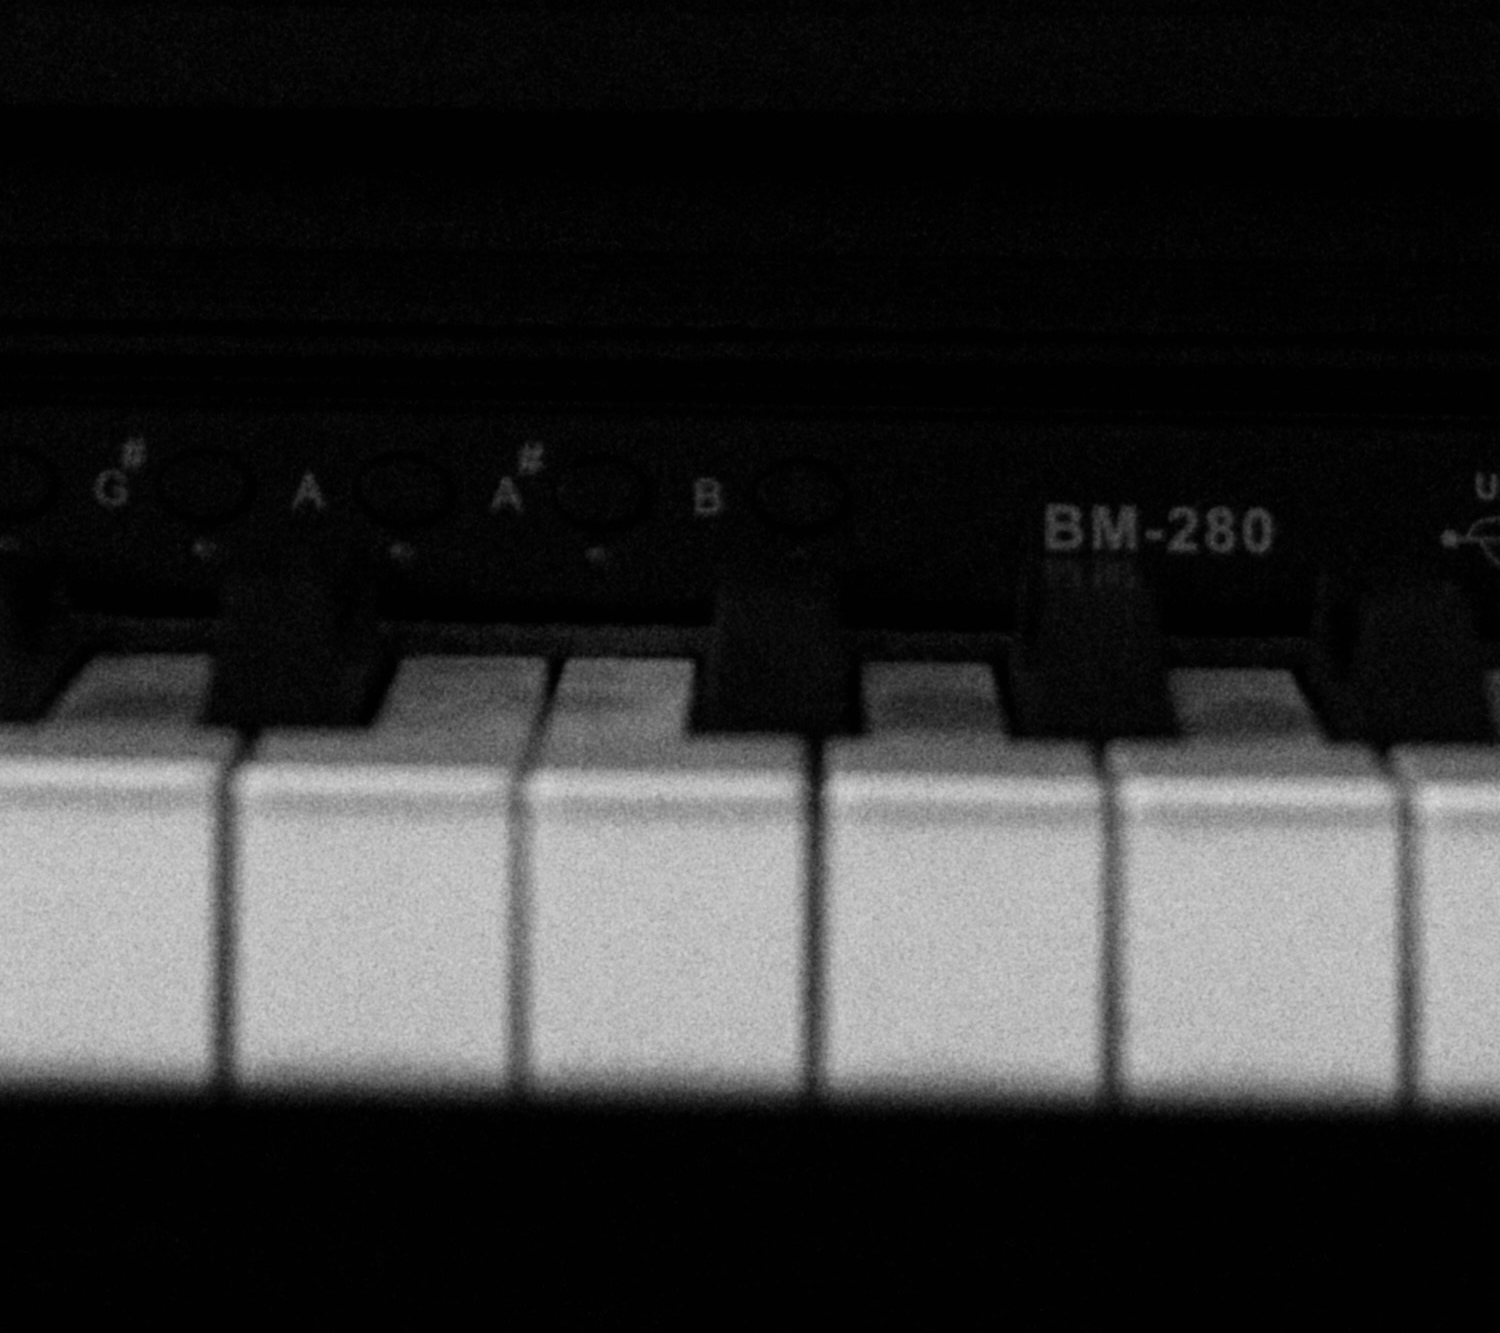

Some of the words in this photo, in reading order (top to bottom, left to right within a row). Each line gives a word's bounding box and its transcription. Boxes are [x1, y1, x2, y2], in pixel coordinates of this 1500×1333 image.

[293, 472, 325, 509] A
[694, 477, 724, 517] B
[1044, 503, 1275, 555] BM-280
